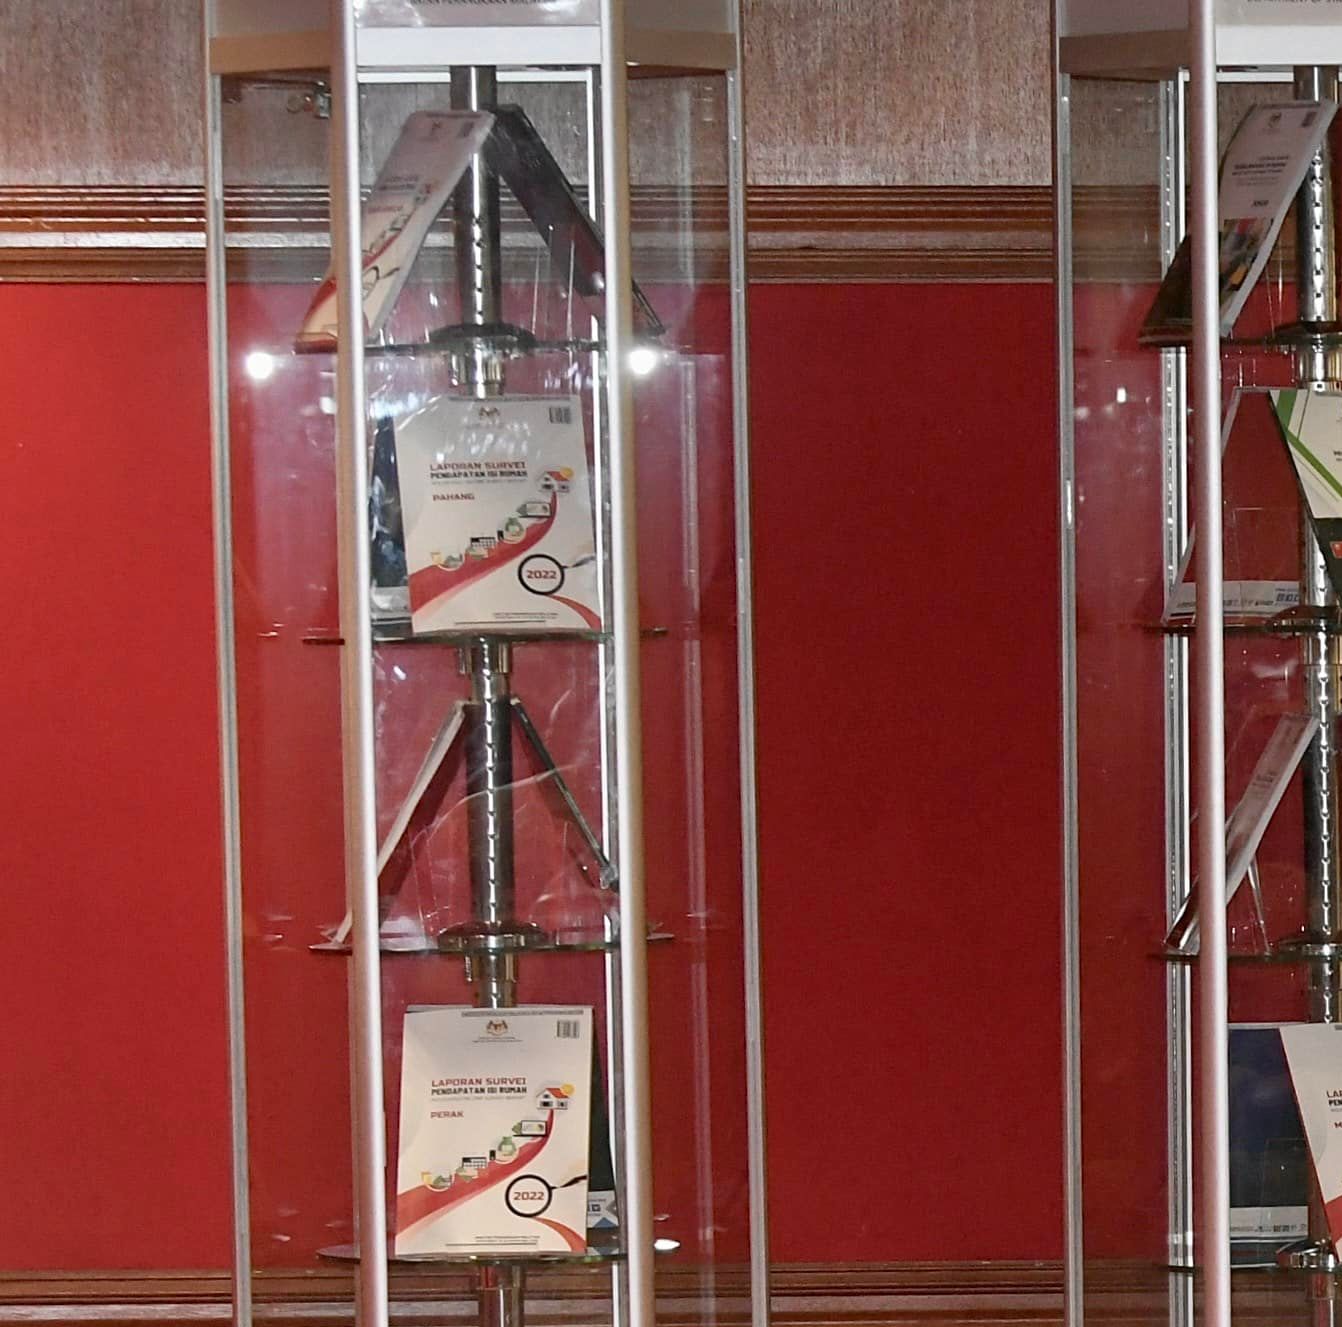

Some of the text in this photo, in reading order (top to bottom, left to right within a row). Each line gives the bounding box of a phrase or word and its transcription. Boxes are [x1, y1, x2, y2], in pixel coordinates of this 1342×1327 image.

[432, 493, 475, 501] PAHANG
[526, 570, 557, 579] 2022
[431, 1077, 527, 1087] LAPORAN SURVEI
[431, 1087, 486, 1095] PENDAPATAN
[430, 1111, 465, 1119] PERAK
[513, 1191, 545, 1201] 2022
